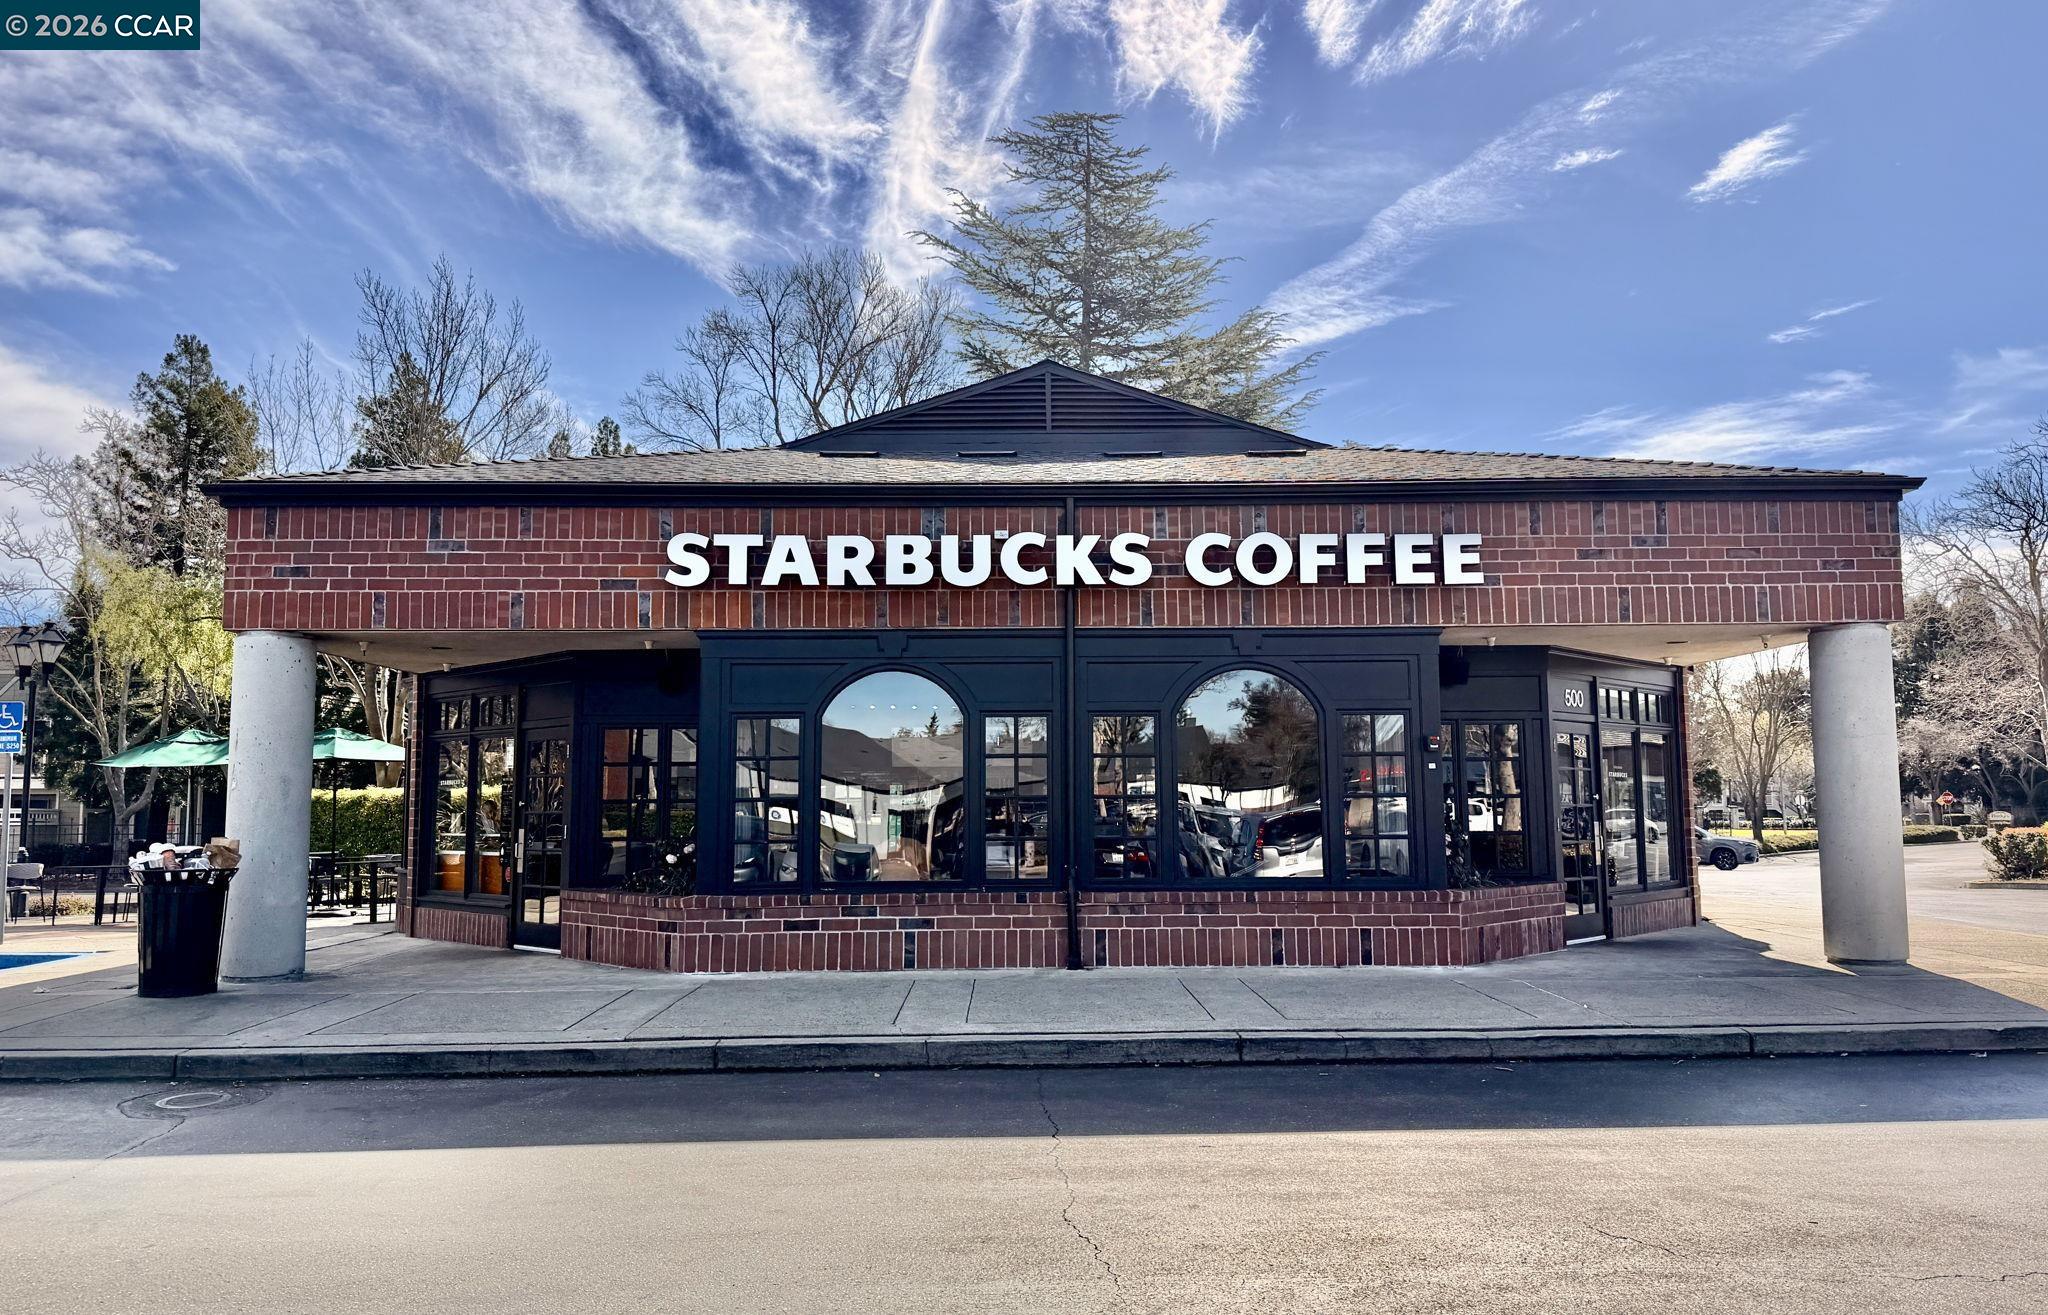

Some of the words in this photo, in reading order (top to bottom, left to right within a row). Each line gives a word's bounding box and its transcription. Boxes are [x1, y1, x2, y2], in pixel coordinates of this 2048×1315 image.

[664, 531, 1153, 587] STARBUCKS
[1185, 531, 1484, 587] COFFEE
[1564, 688, 1584, 708] 500
